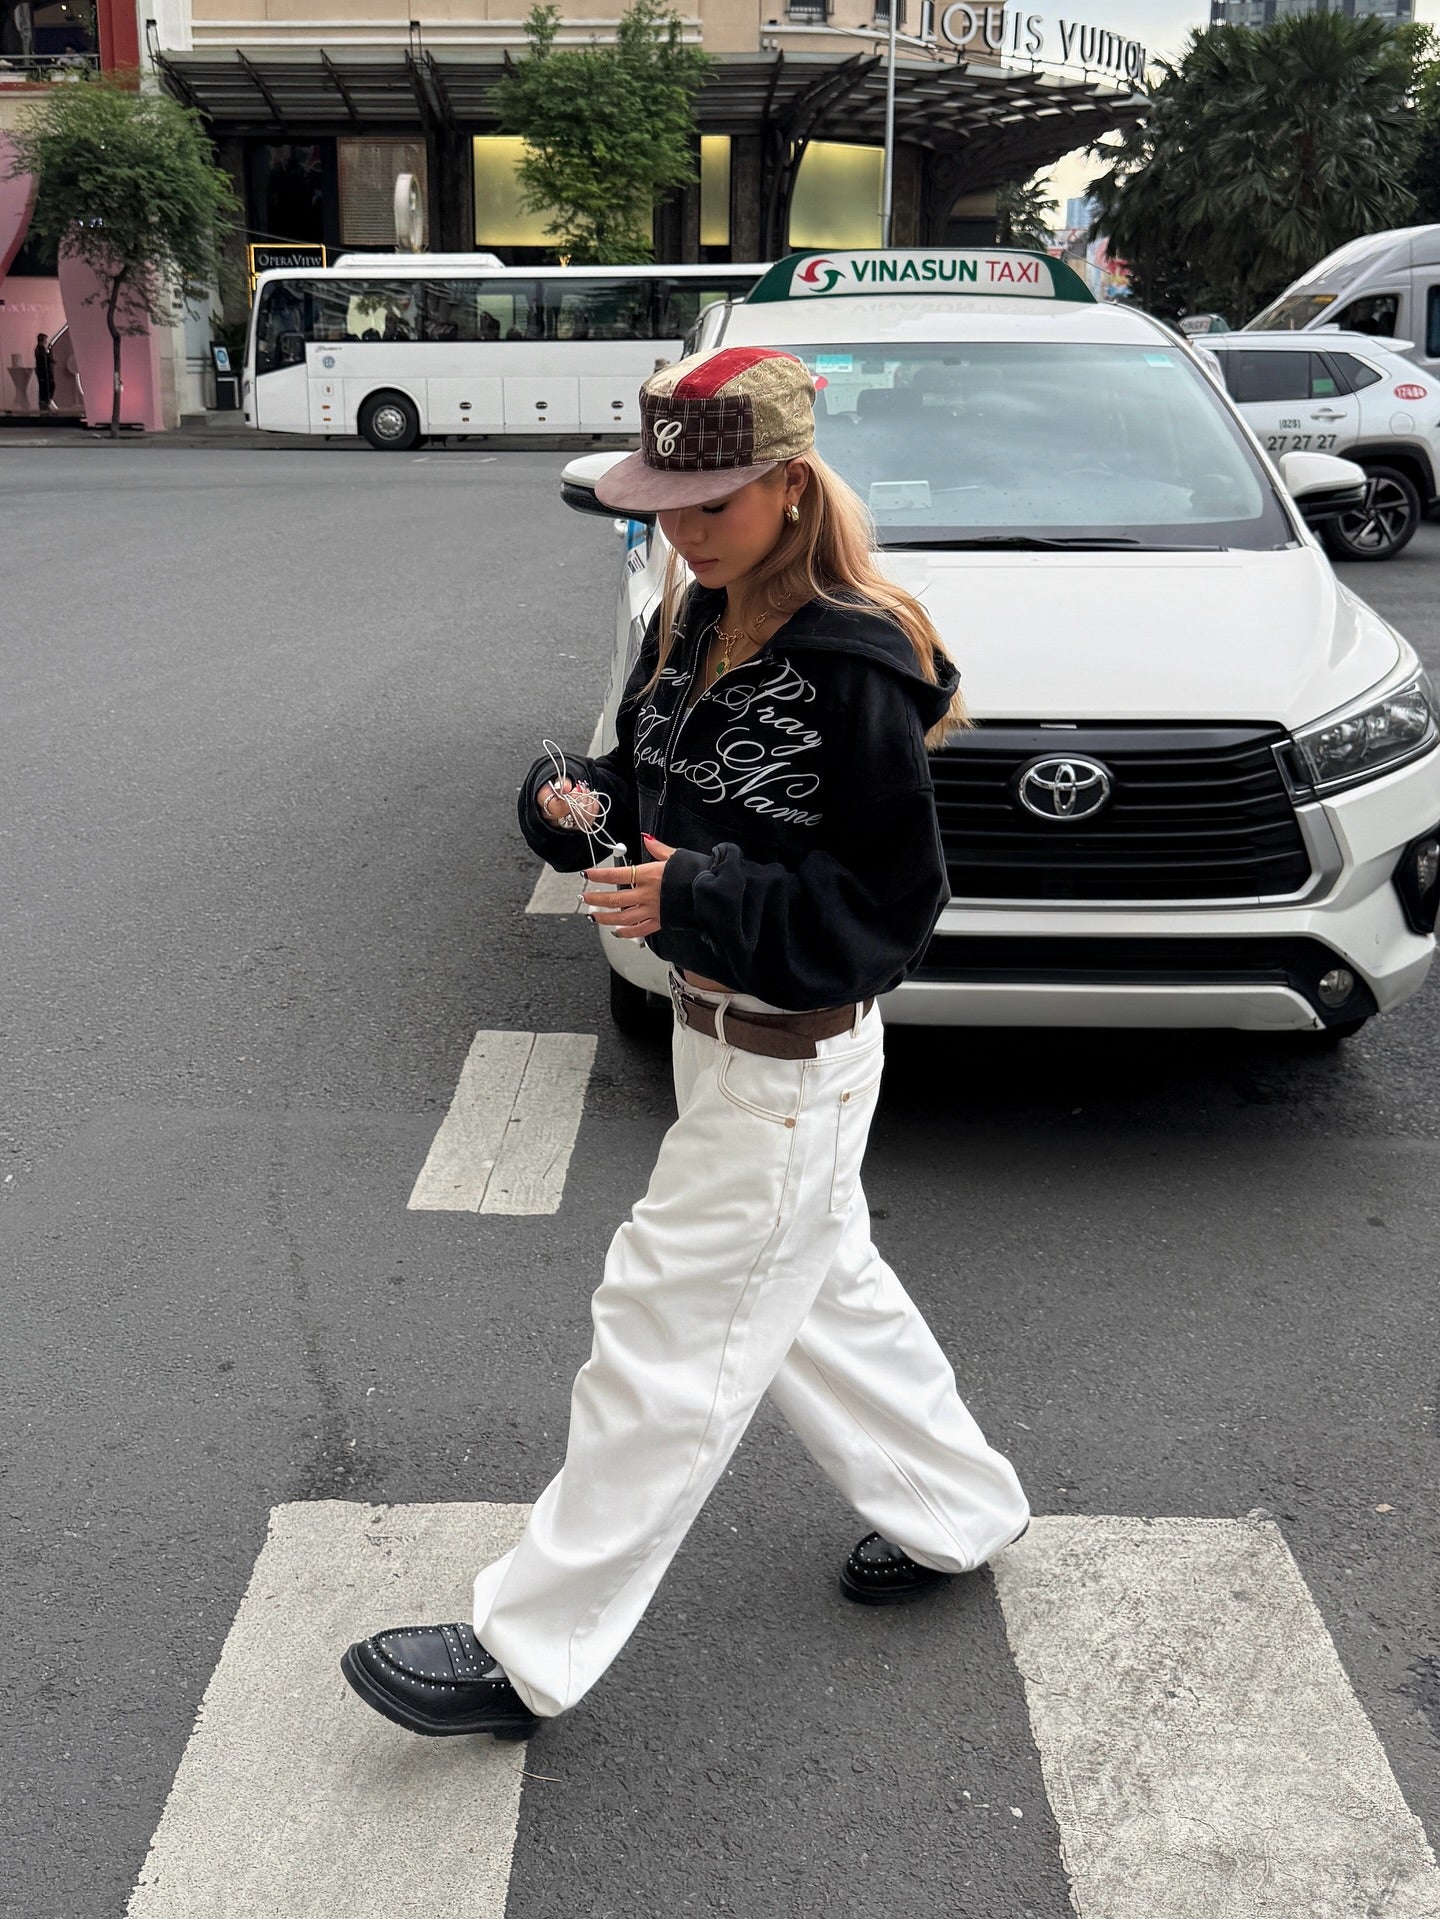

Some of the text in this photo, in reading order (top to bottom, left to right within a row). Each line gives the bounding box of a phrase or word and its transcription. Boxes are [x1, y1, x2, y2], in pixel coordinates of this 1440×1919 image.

[921, 0, 1147, 82] LOUIS VUITTON
[851, 259, 1040, 283] VINASUN TAXI
[653, 419, 682, 457] C
[1267, 434, 1337, 451] 27 27 27
[684, 727, 823, 826] Name
